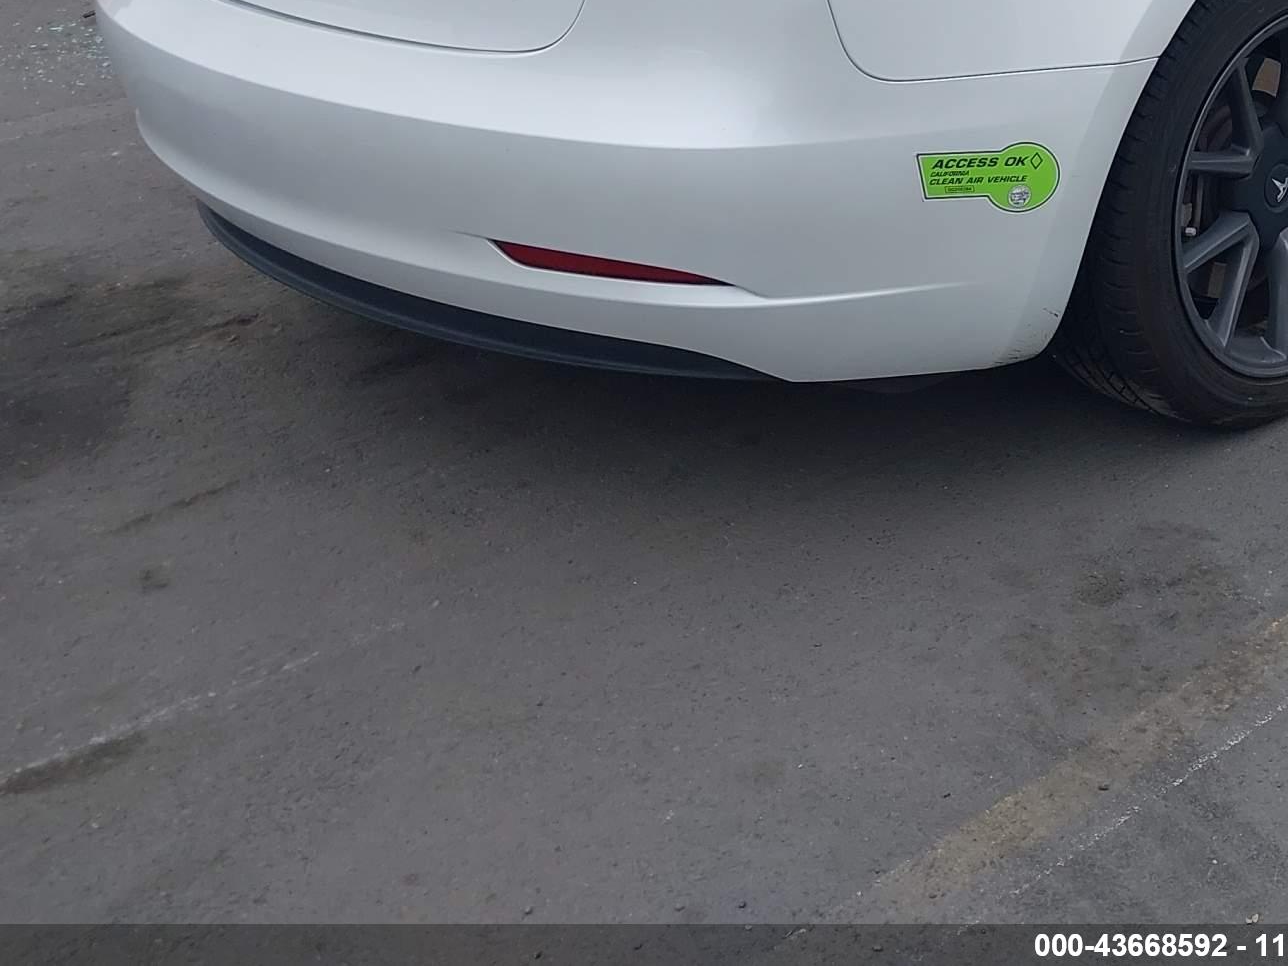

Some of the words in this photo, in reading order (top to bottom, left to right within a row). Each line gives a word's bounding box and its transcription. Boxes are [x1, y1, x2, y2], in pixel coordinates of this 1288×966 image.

[932, 157, 998, 169] ACCESS
[1004, 156, 1029, 167] OK
[929, 177, 962, 185] CLEAN
[987, 175, 1028, 183] VEHICLE
